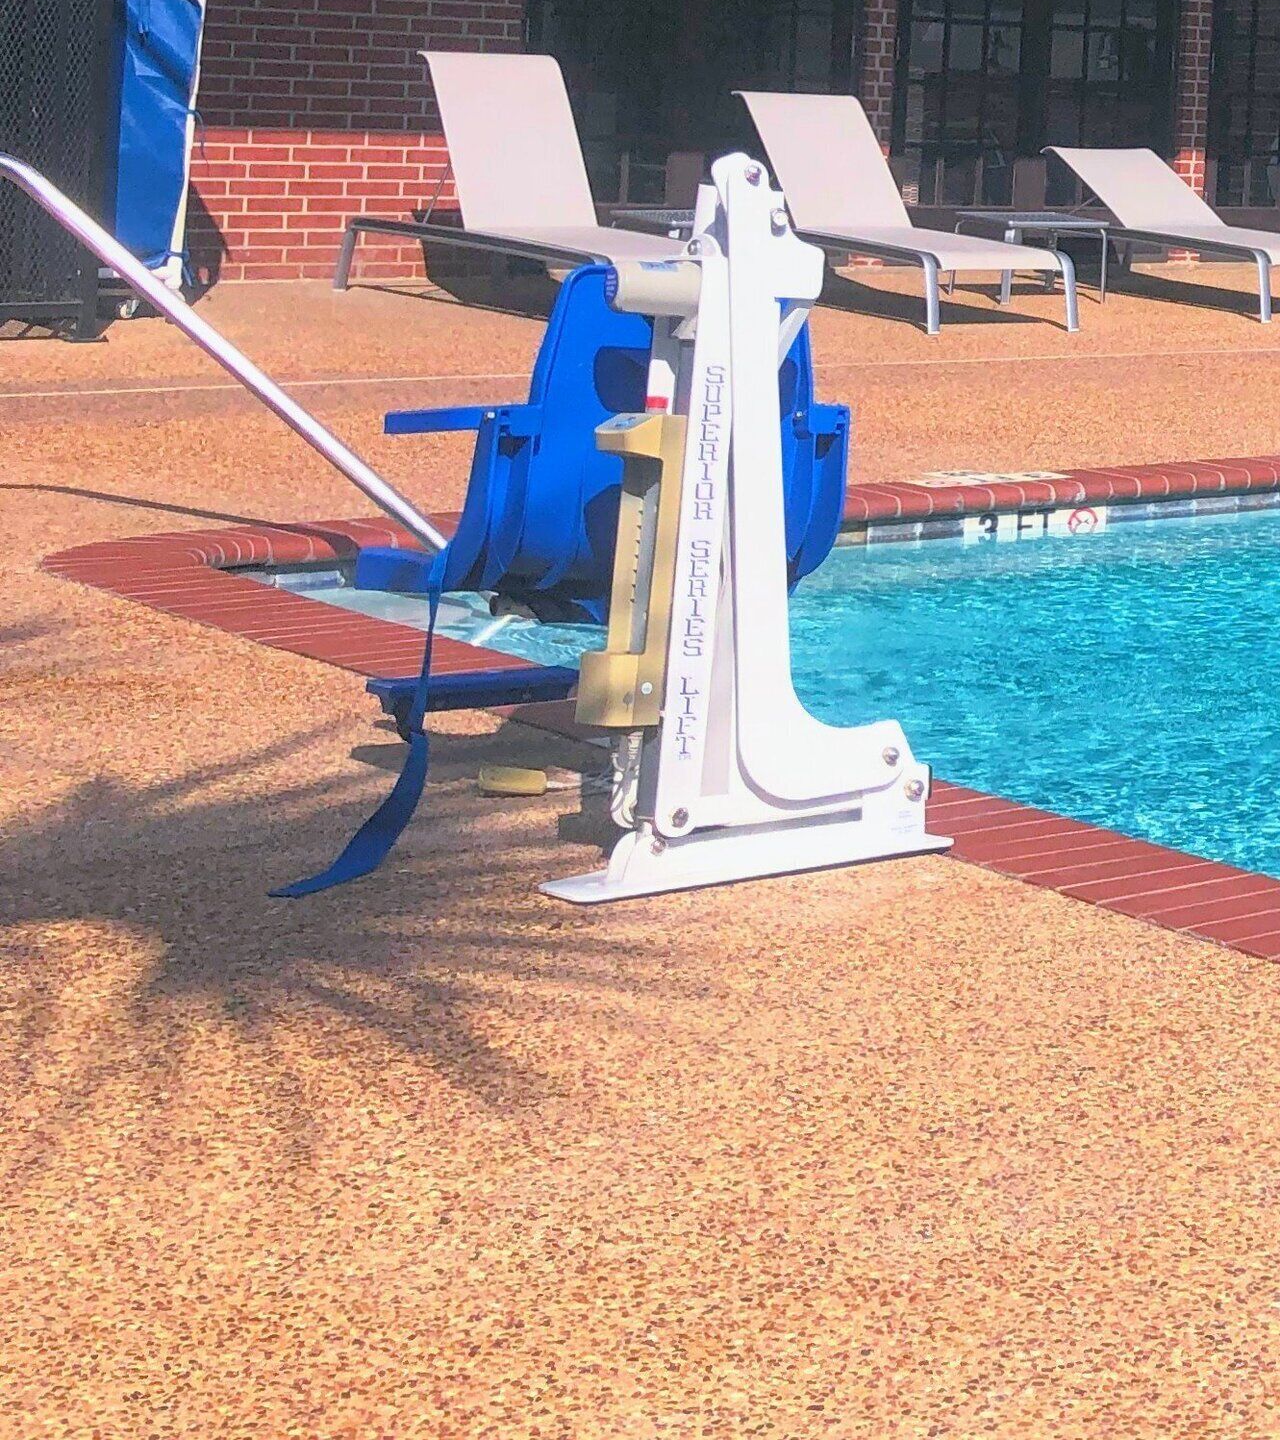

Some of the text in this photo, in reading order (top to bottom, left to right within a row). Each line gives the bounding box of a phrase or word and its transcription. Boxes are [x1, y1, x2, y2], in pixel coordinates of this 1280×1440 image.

[675, 366, 725, 755] SUPERIOR SERIES LIFT
[1017, 508, 1056, 534] FT
